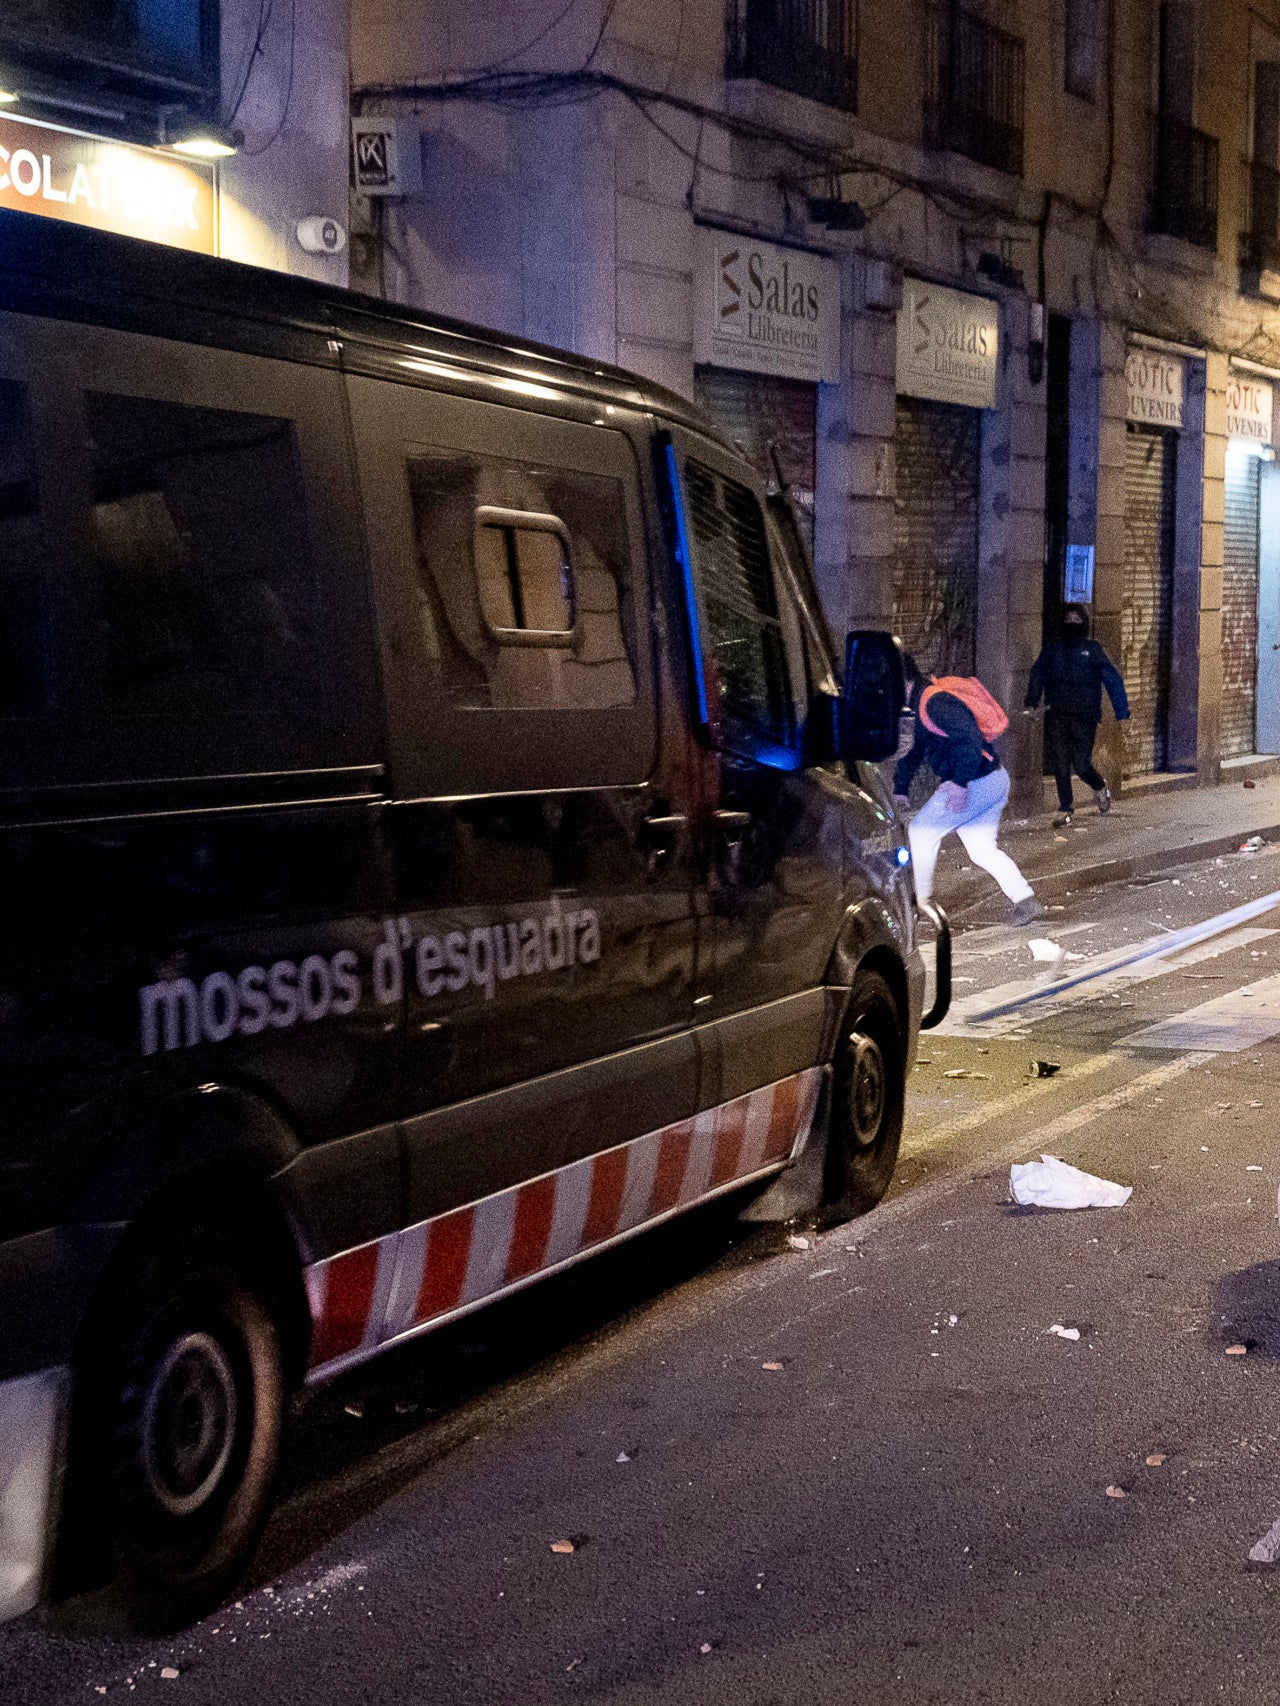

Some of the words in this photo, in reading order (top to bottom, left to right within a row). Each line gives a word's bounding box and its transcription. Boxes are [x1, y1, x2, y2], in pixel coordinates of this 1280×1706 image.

[747, 252, 819, 321] Salas
[747, 312, 819, 350] Llibreteria
[935, 303, 987, 356] Salas
[139, 950, 361, 1056] mossos
[373, 895, 600, 1004] d'esquadra
